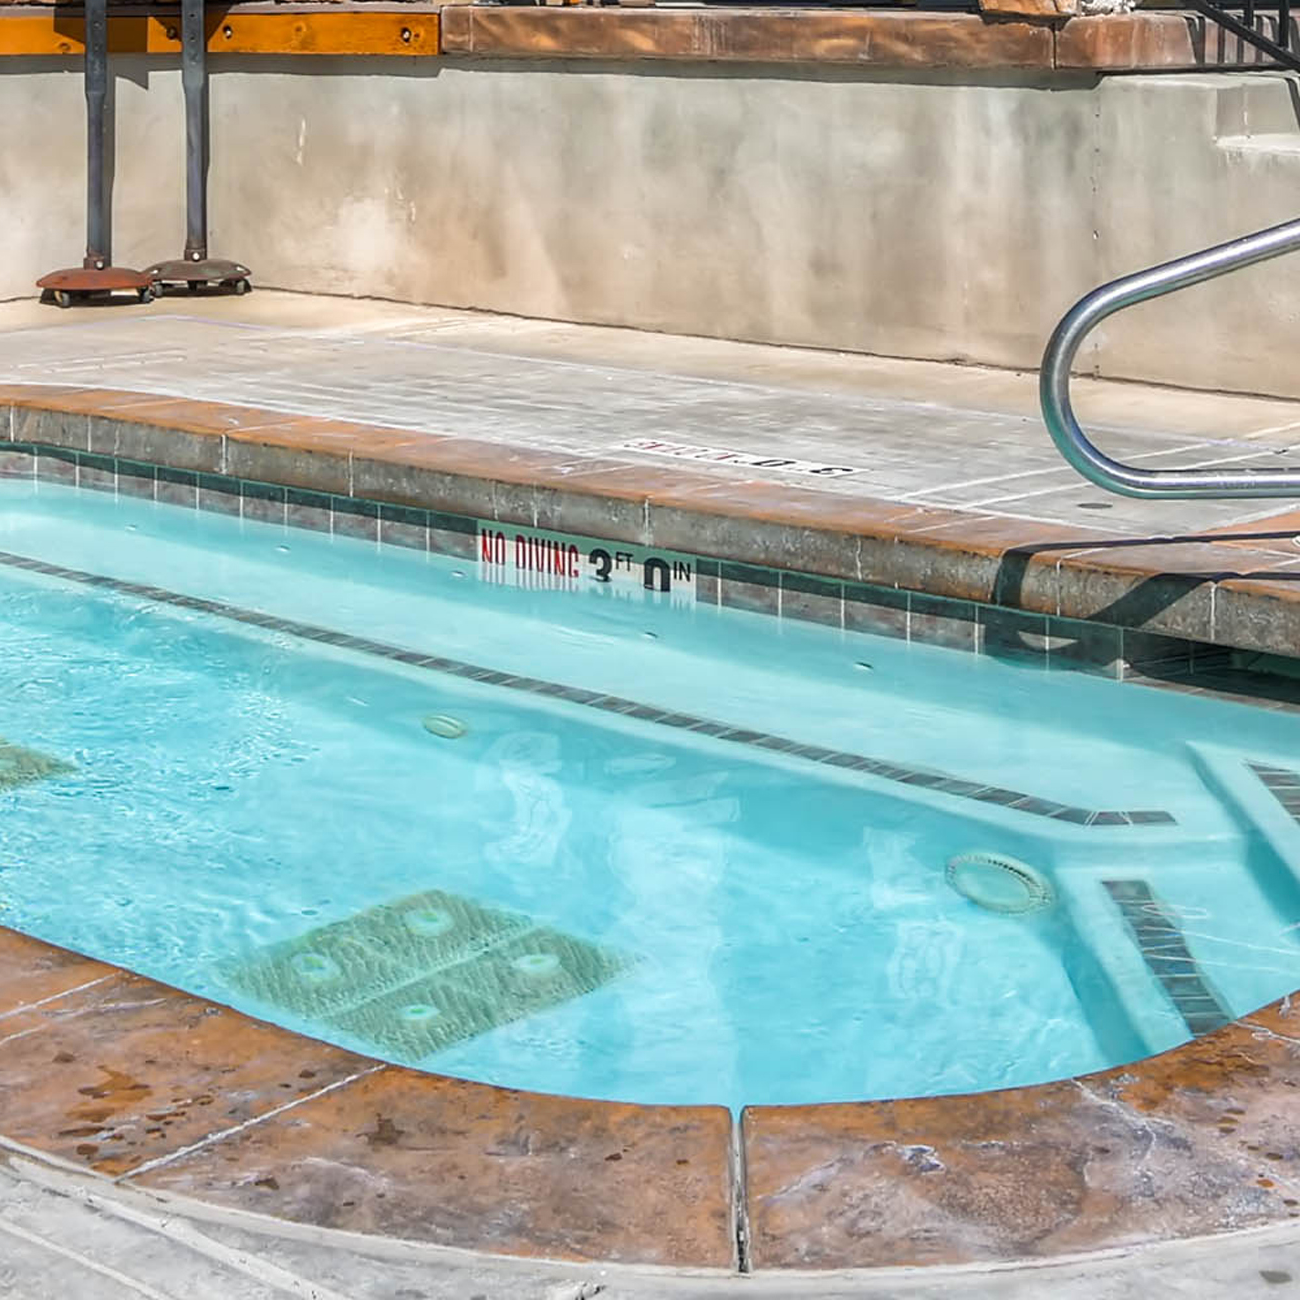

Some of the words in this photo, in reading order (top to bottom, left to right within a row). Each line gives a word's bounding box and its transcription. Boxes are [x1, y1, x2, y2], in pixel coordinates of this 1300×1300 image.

[481, 528, 506, 566] NO
[515, 534, 580, 579] DIVING
[588, 548, 613, 583] 3
[615, 551, 634, 572] FT
[673, 561, 691, 582] IN
